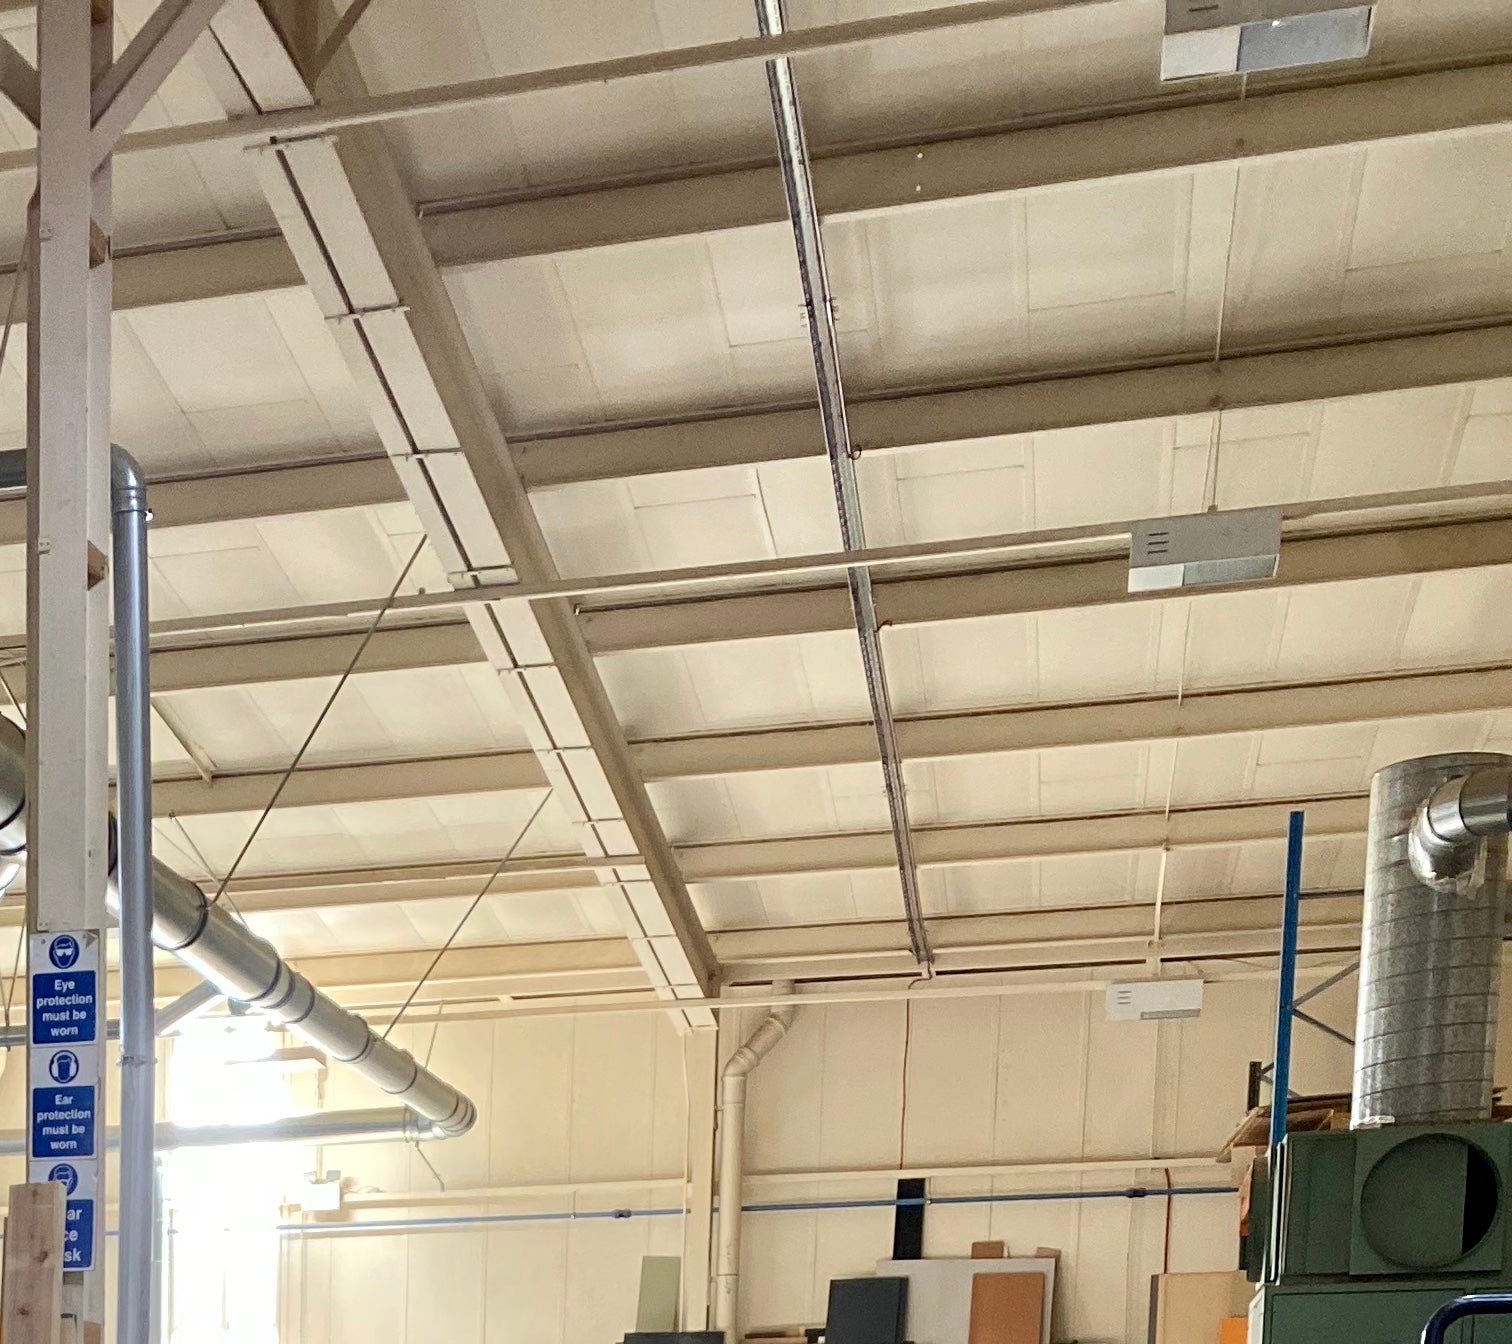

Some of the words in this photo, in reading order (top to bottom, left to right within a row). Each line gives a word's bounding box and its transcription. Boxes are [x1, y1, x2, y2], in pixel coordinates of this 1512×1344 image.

[54, 979, 75, 992] Eye
[36, 994, 93, 1009] protection
[42, 1010, 70, 1022] must
[72, 1009, 87, 1020] be
[50, 1026, 78, 1037] worn
[54, 1094, 73, 1105] Ear
[36, 1110, 91, 1123] protection
[42, 1124, 69, 1135] must
[72, 1123, 85, 1134] be
[50, 1139, 78, 1150] worn
[67, 1209, 83, 1220] ar
[64, 1247, 81, 1262] sk
